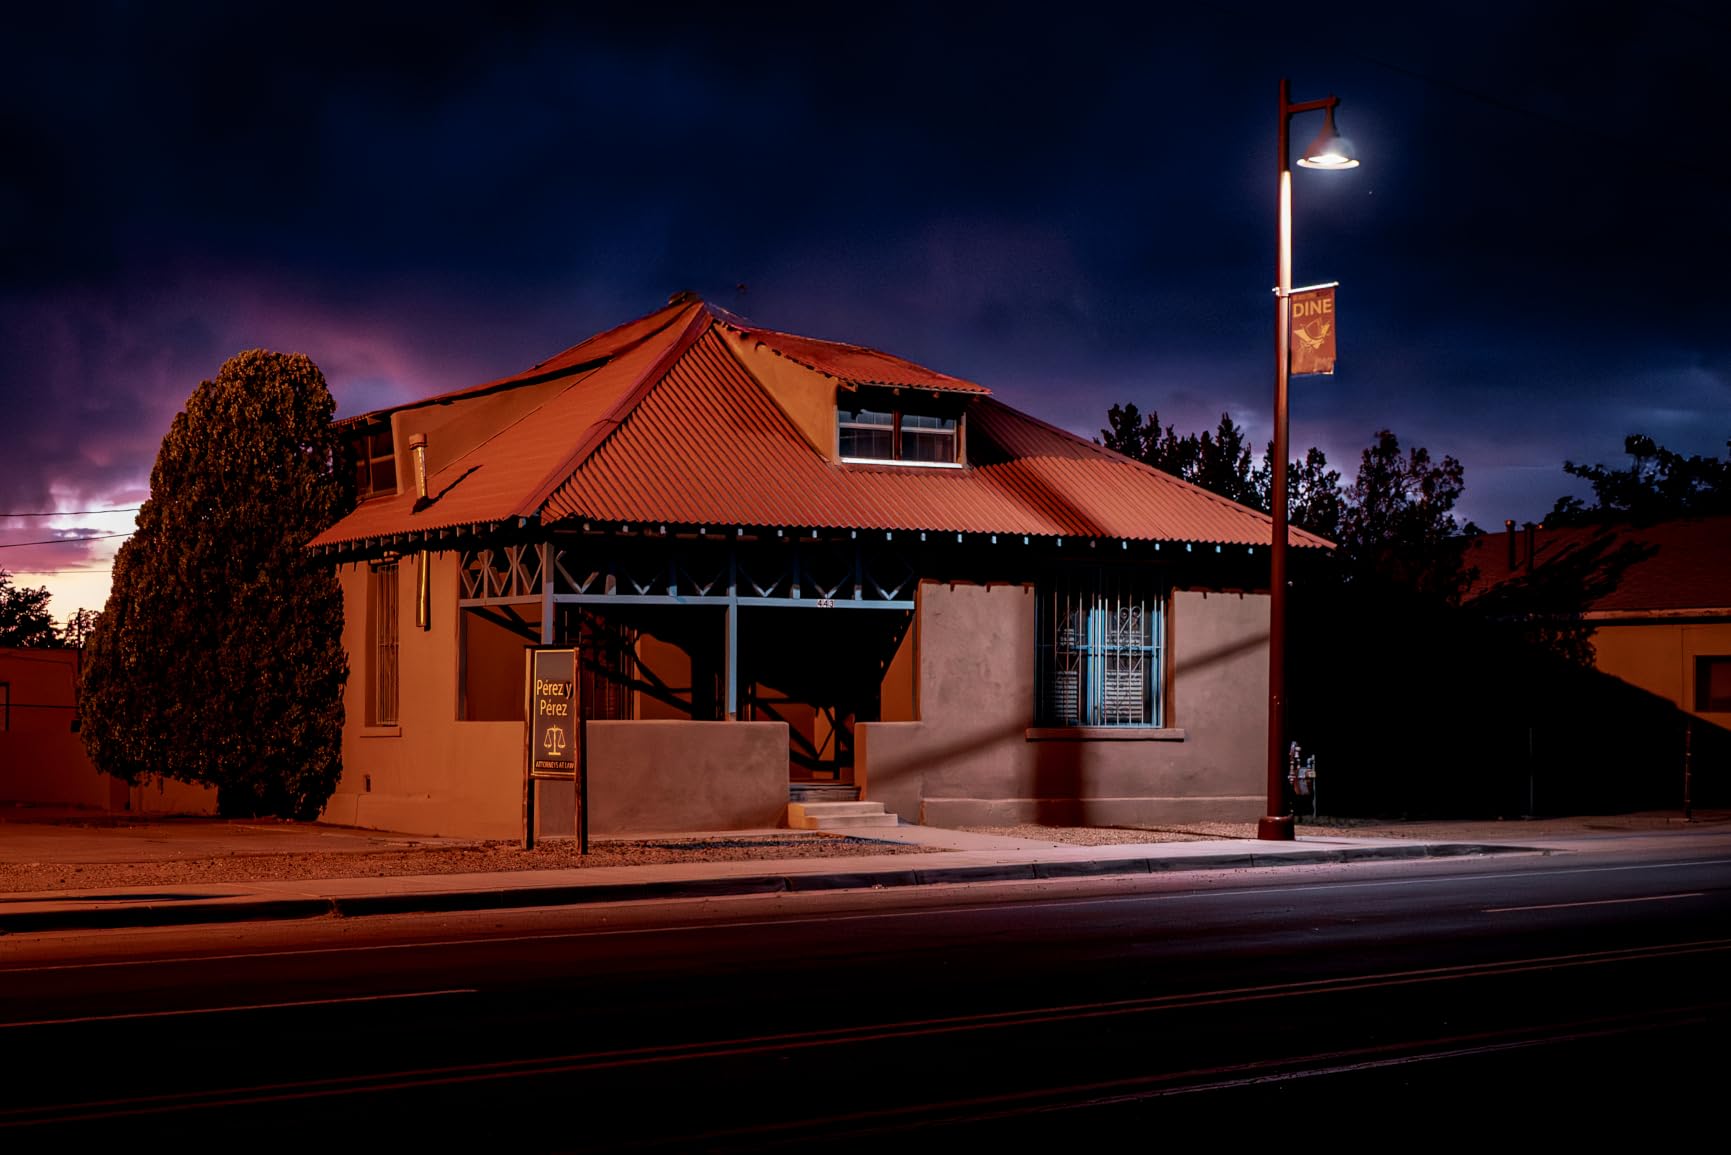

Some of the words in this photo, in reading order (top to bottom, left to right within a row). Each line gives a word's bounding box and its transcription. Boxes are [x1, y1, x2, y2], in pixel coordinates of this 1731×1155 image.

[1293, 298, 1332, 318] DINE
[817, 600, 834, 608] 443
[536, 680, 564, 696] Pérez
[565, 683, 572, 700] y
[540, 699, 568, 716] Pérez
